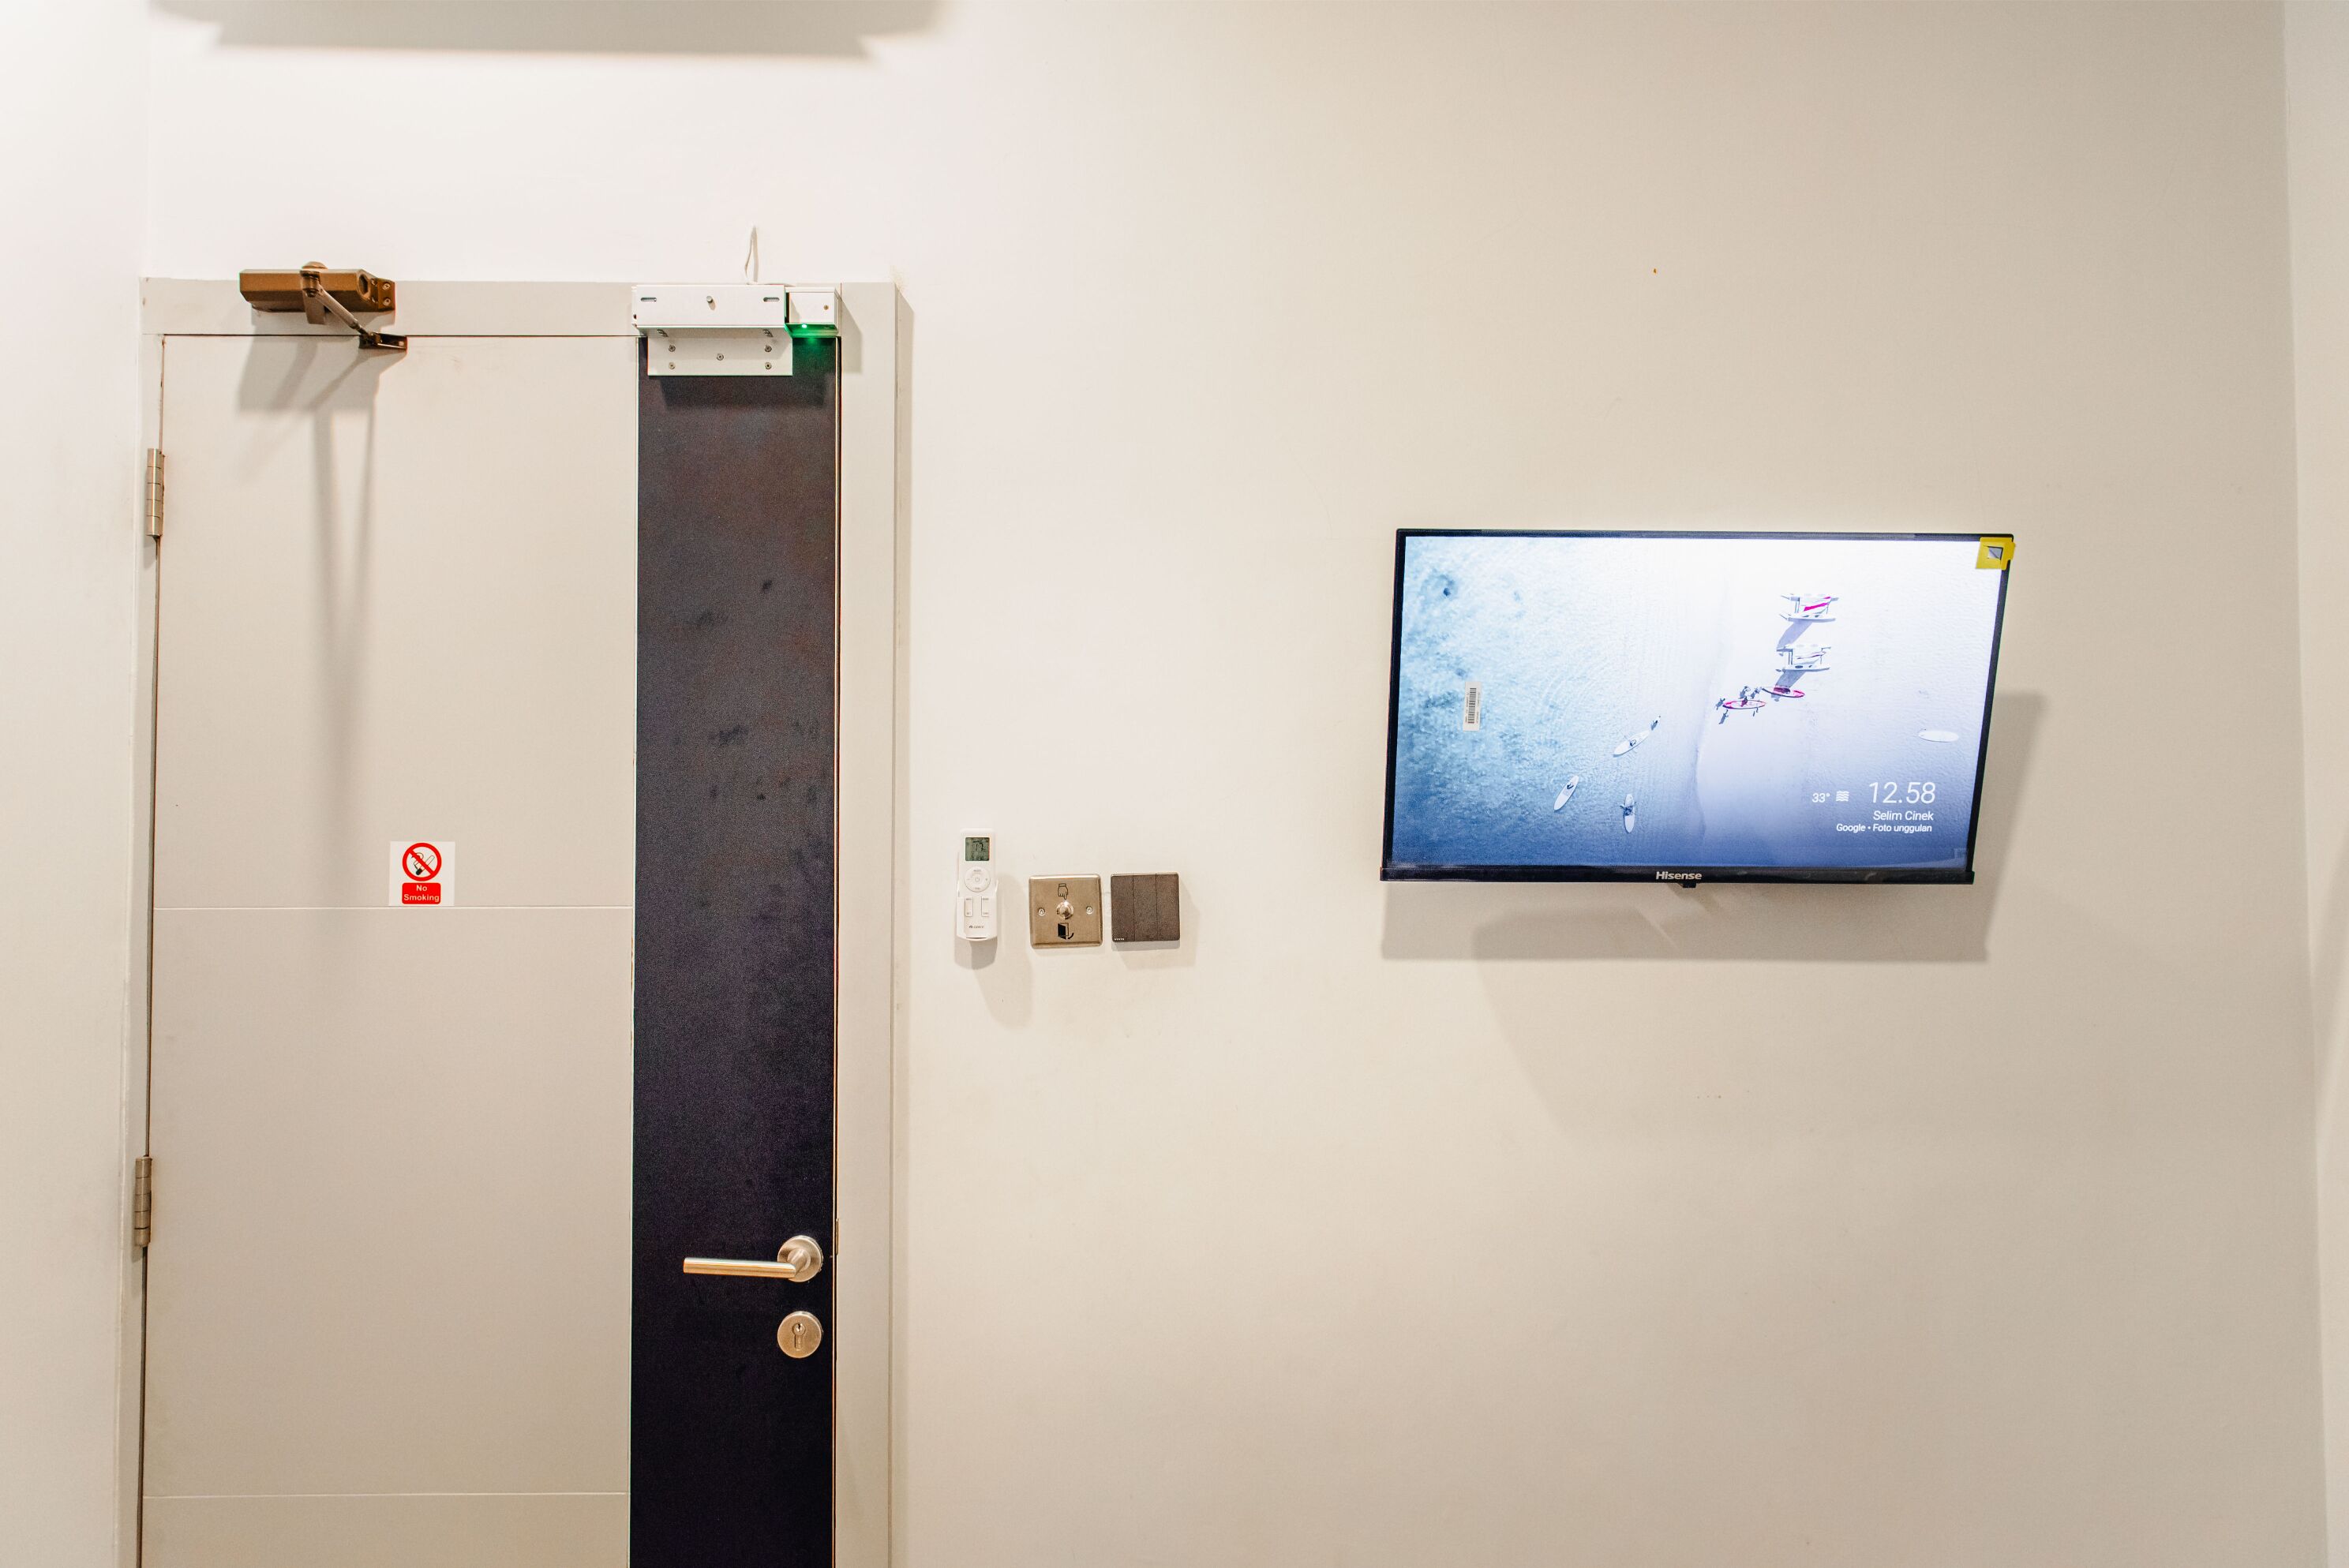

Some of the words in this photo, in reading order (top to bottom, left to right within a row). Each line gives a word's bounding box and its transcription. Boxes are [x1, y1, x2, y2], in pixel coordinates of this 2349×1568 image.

[1868, 781, 1936, 804] 12.58
[1872, 810, 1902, 821] Selim
[1905, 810, 1935, 821] Cinek
[1836, 823, 1866, 833] Google
[1872, 823, 1892, 833] Foto
[1894, 824, 1932, 834] unggulan
[1655, 870, 1703, 880] Hisense
[403, 893, 440, 903] Smoking
